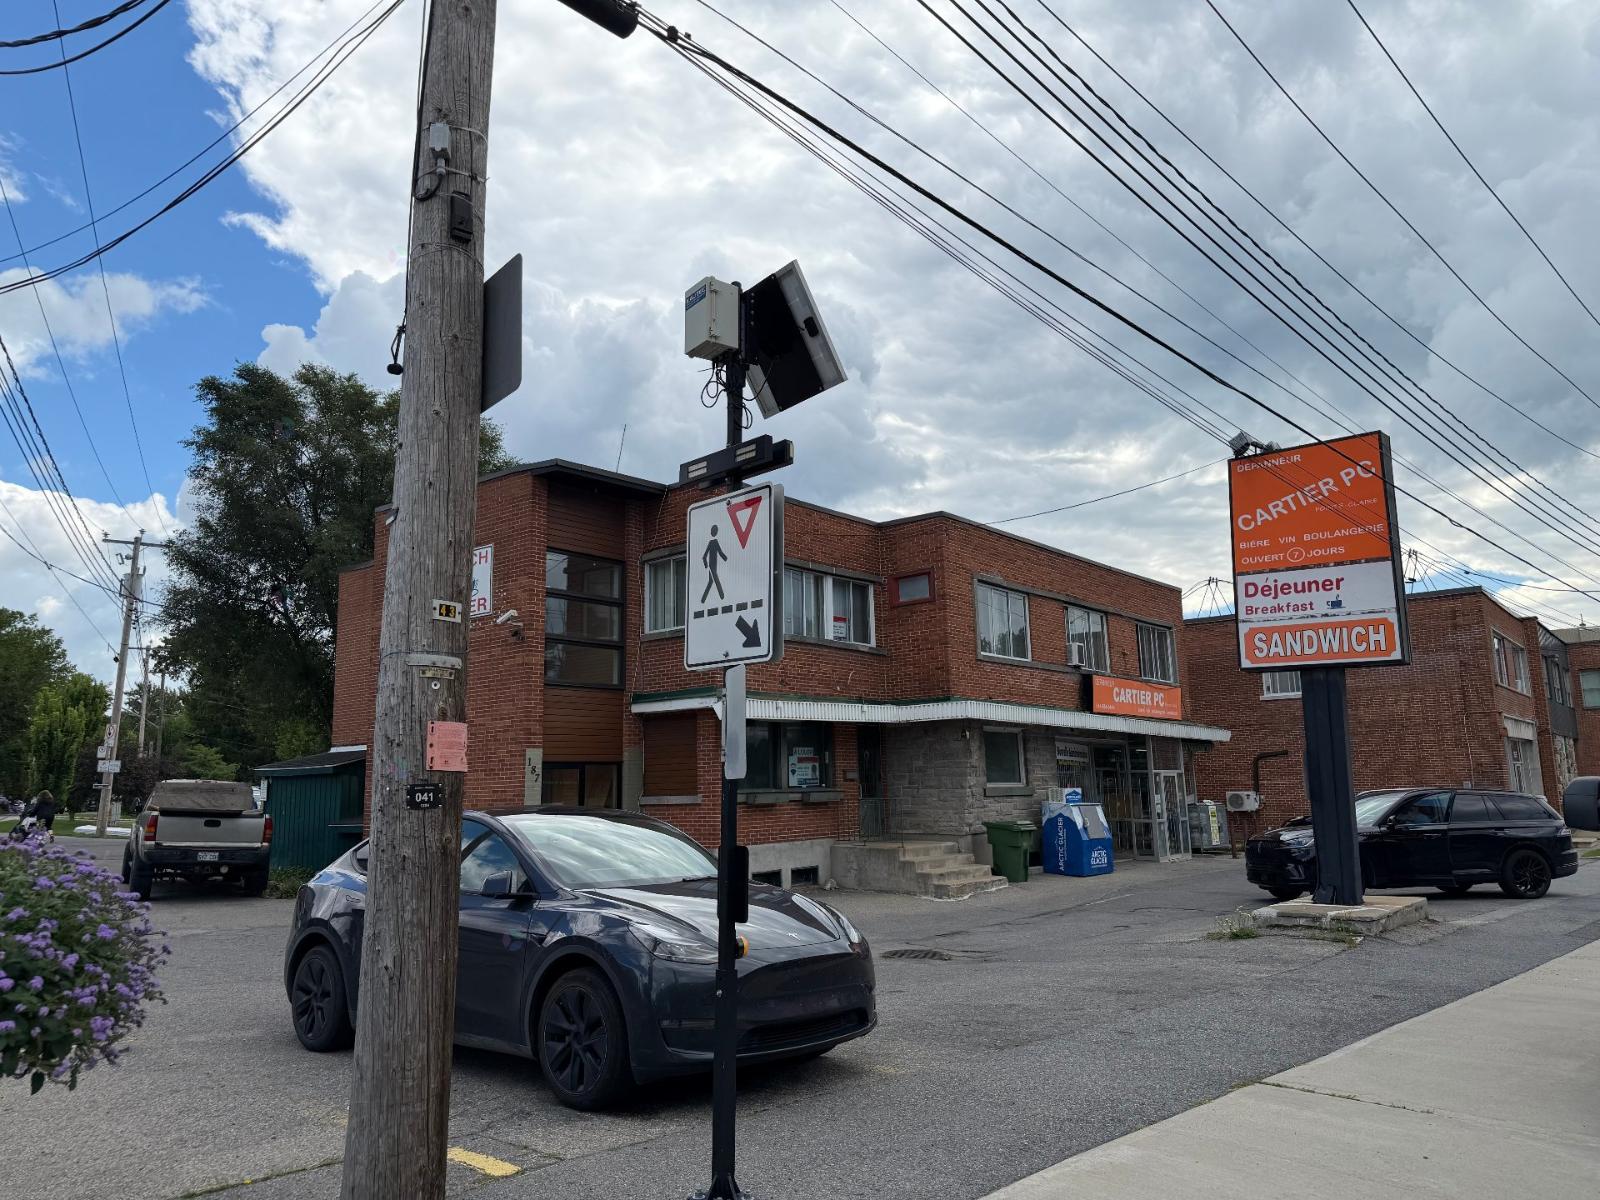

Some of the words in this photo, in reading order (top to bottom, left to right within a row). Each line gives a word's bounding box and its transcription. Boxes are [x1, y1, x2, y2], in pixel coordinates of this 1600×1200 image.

[1238, 477, 1339, 531] CARTIER
[1339, 460, 1376, 486] PC
[1278, 536, 1296, 544] VIN
[1304, 523, 1385, 541] BOULANGERIE
[1241, 552, 1285, 564] OUVERT
[1307, 546, 1345, 558] JOURS
[1244, 575, 1345, 599] Déjeuner
[1245, 601, 1315, 615] Breakfast
[1253, 624, 1386, 658] SANDWICH
[1113, 687, 1152, 706] CARTIER
[1154, 693, 1165, 707] PC
[415, 792, 433, 802] 041
